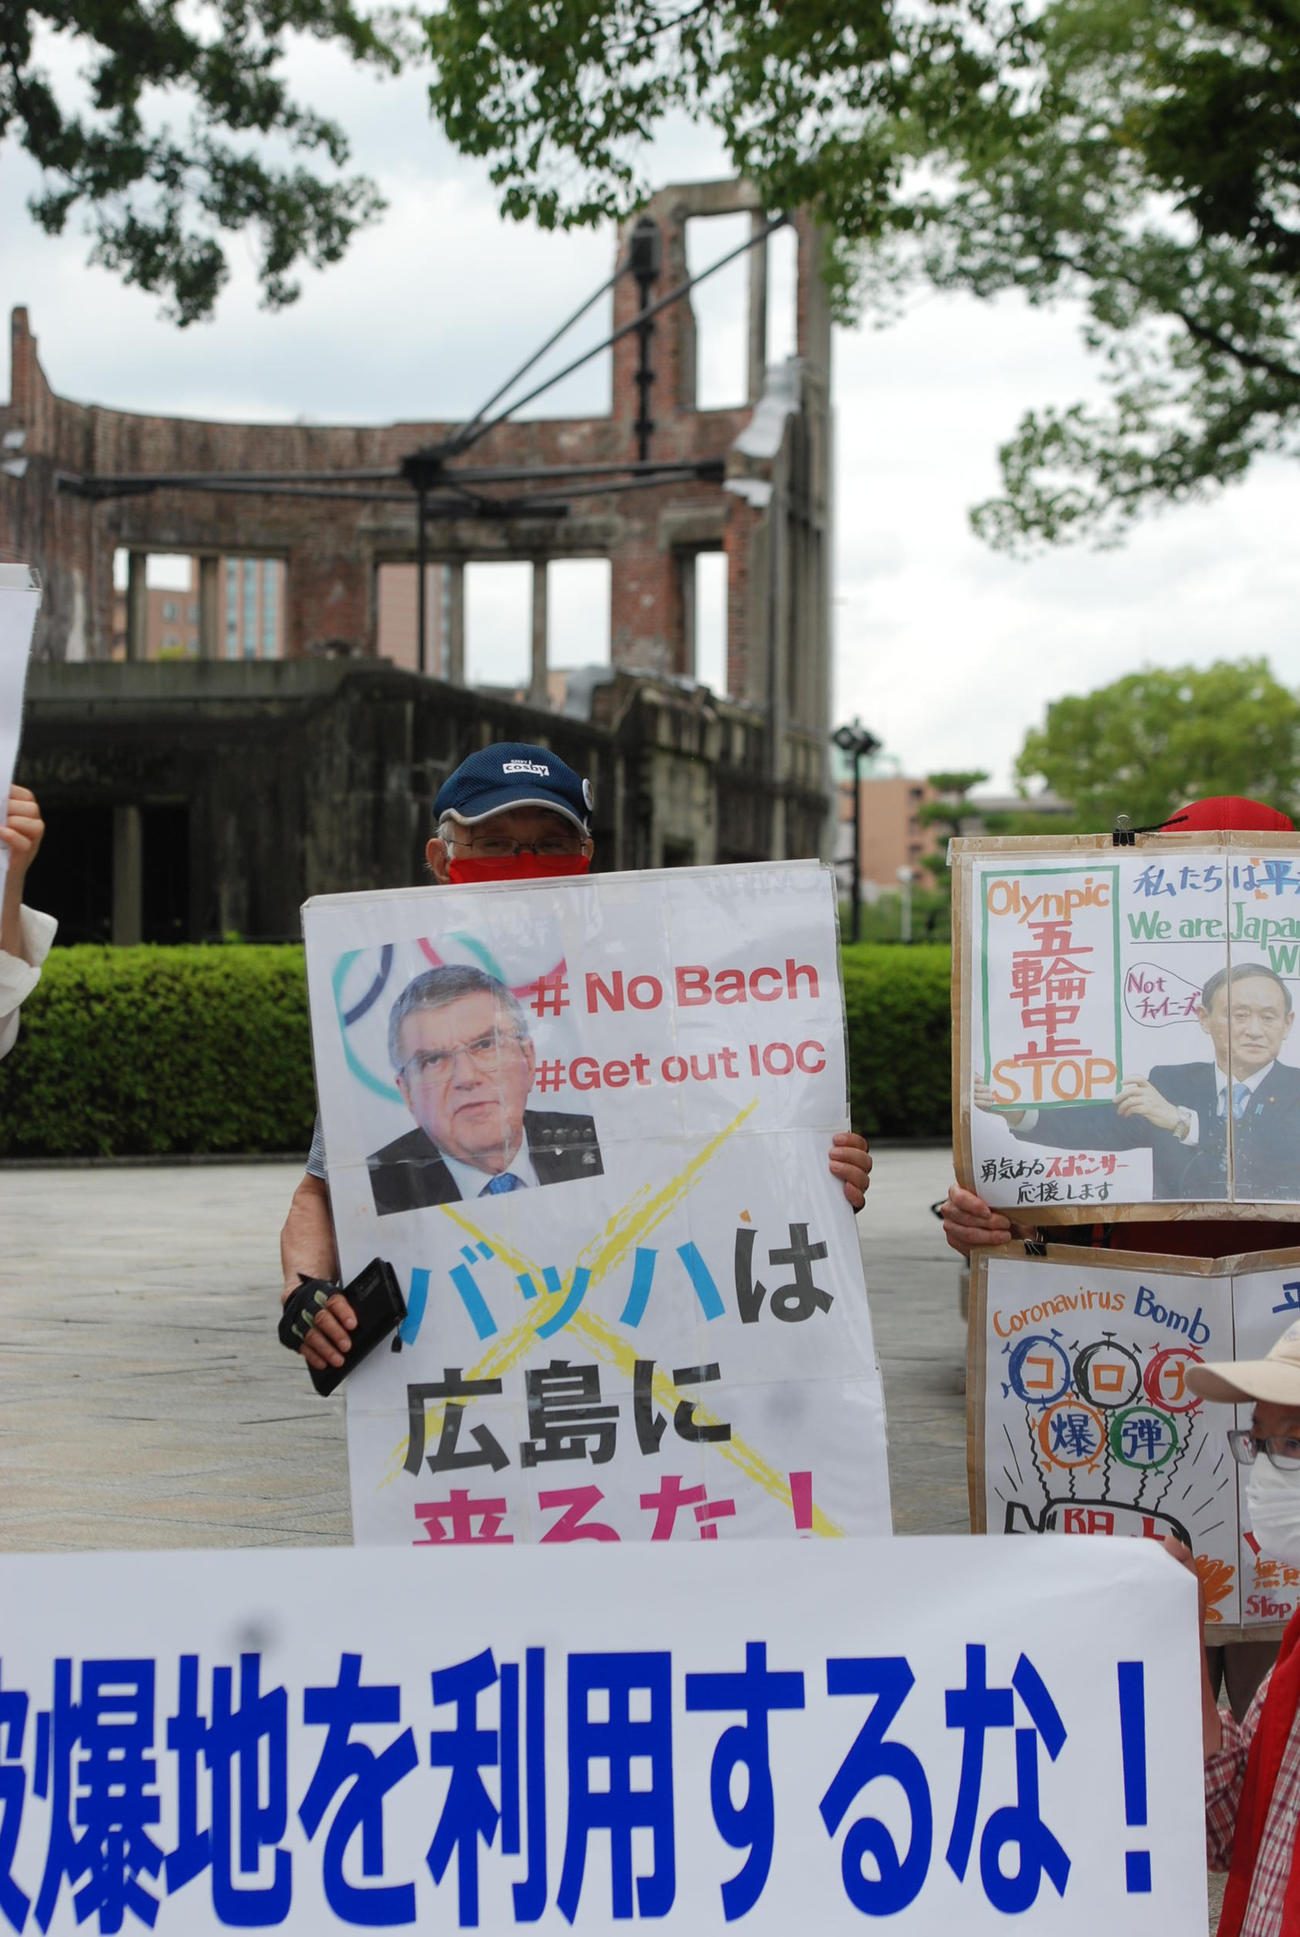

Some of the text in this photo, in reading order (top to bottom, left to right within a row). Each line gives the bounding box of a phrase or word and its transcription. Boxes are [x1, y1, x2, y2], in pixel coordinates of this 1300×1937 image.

[1127, 910, 1172, 940] We
[1223, 902, 1300, 950] Japa
[585, 970, 663, 1013] No
[675, 959, 820, 1007] Bach
[1009, 920, 1095, 1062] 五輪中止
[1127, 971, 1166, 994] Not
[535, 1040, 826, 1092] #Get out IOC
[991, 1057, 1117, 1104] STOP
[1017, 1180, 1113, 1205] 応援します
[400, 1222, 834, 1346] バッハは
[993, 1287, 1126, 1338] Coronavirus
[1134, 1286, 1210, 1344] Bomb
[402, 1360, 731, 1476] 広島に
[1050, 1413, 1166, 1460] 爆弾
[1245, 1594, 1292, 1619] Stop
[0, 1642, 1151, 1937] 爆地を利用するな!
